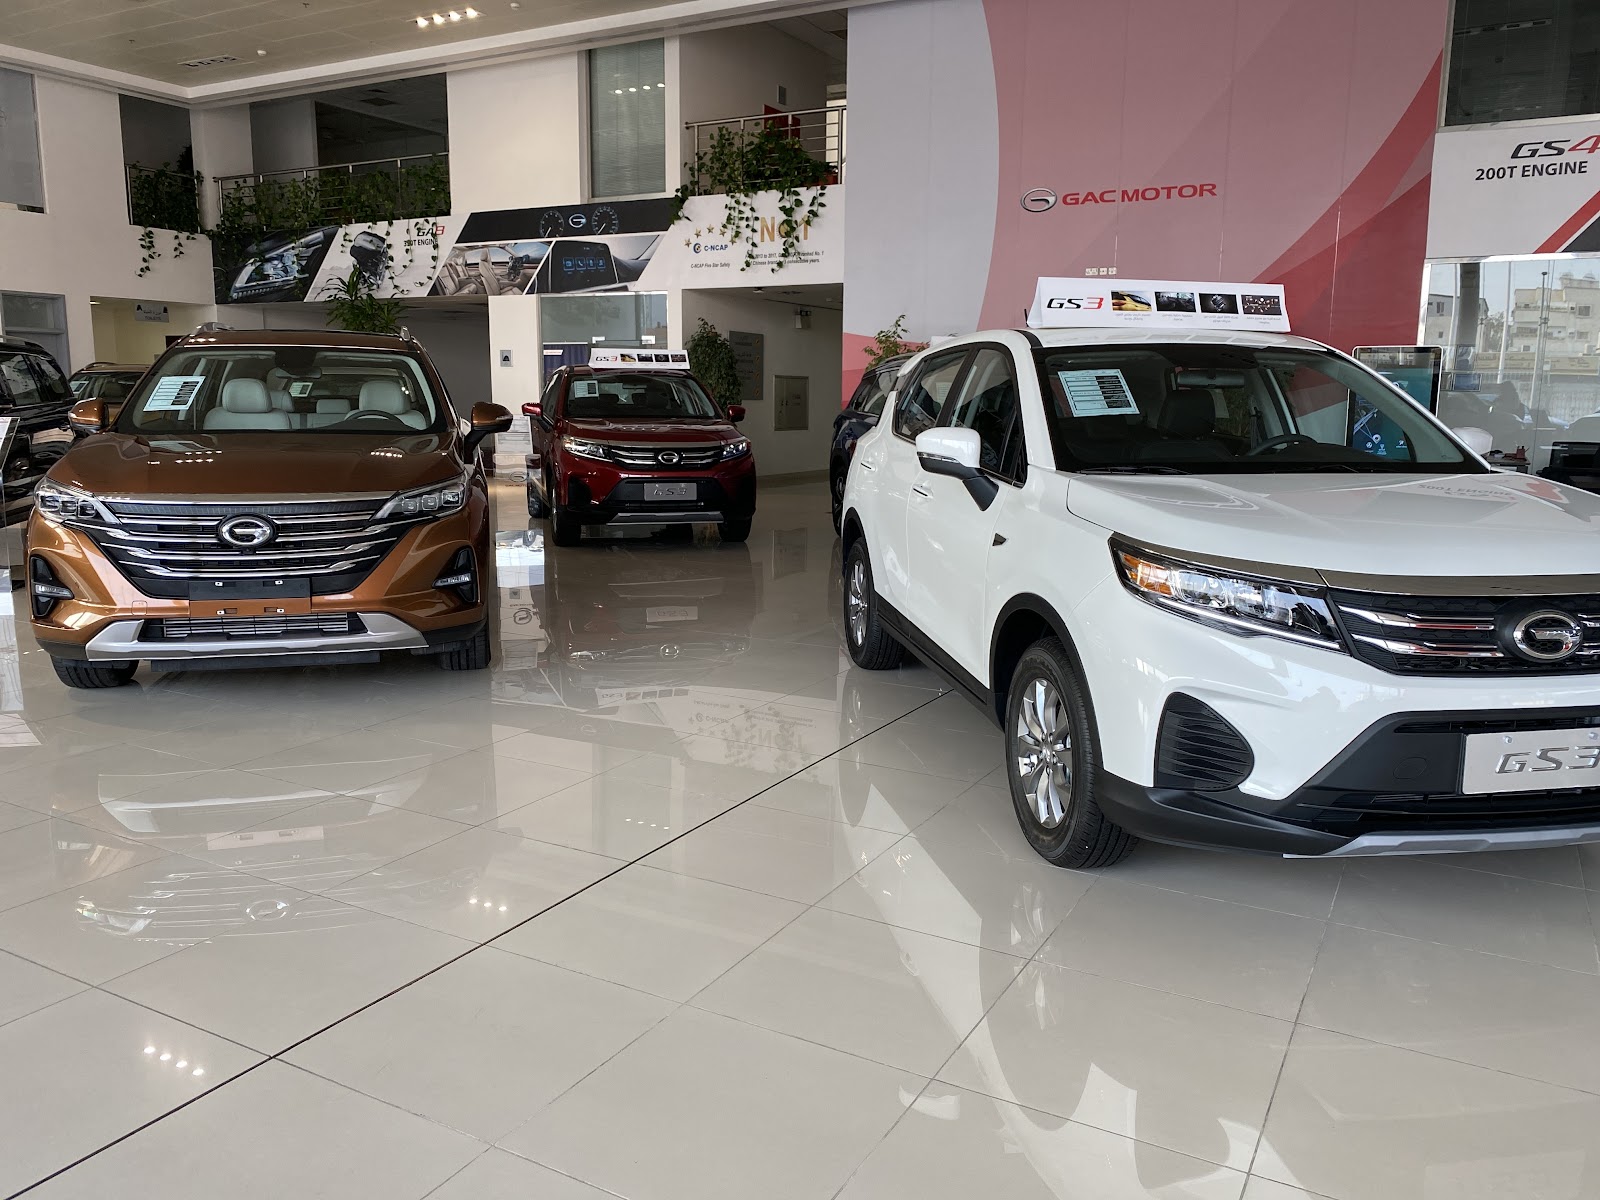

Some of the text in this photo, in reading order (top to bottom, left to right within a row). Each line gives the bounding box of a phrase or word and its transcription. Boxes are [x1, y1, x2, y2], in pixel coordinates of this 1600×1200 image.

[1510, 135, 1600, 159] GS4
[1475, 160, 1588, 181] 200T ENGINE
[1062, 183, 1217, 206] GAC MOTOR
[704, 244, 728, 252] C-NCAP
[1046, 297, 1104, 310] GS3
[653, 487, 687, 496] GS3
[1495, 745, 1600, 774] GS3
